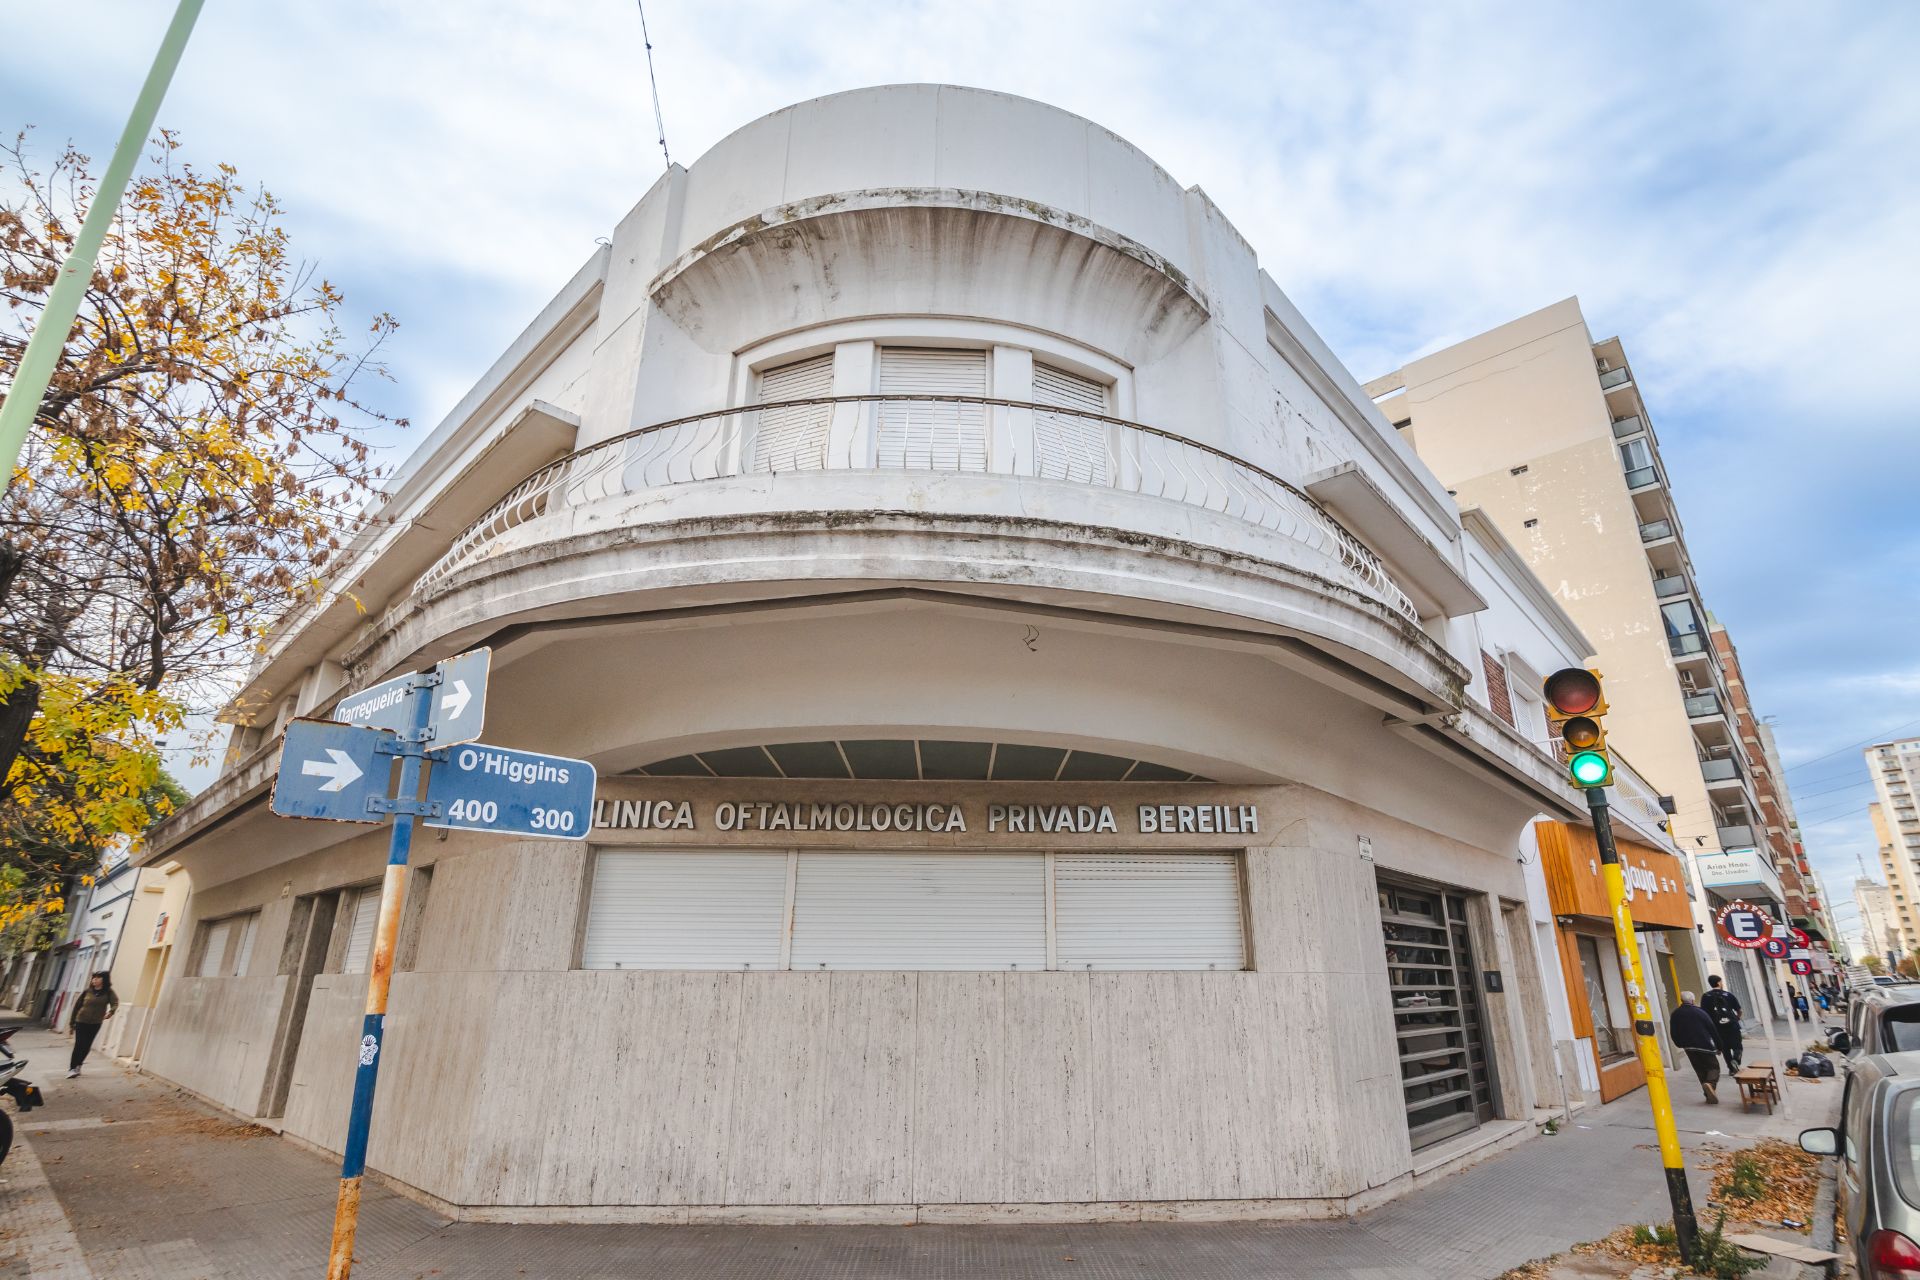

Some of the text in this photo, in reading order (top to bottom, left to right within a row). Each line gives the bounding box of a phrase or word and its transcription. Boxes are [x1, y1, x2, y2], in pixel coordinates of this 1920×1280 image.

[338, 687, 404, 723] Darregueira
[458, 749, 571, 784] O'Higgins
[448, 799, 574, 831] 400 300
[594, 799, 1259, 833] LINICA OFTALMOLOGICA PRIVADA BEREILH
[1731, 912, 1759, 938] E
